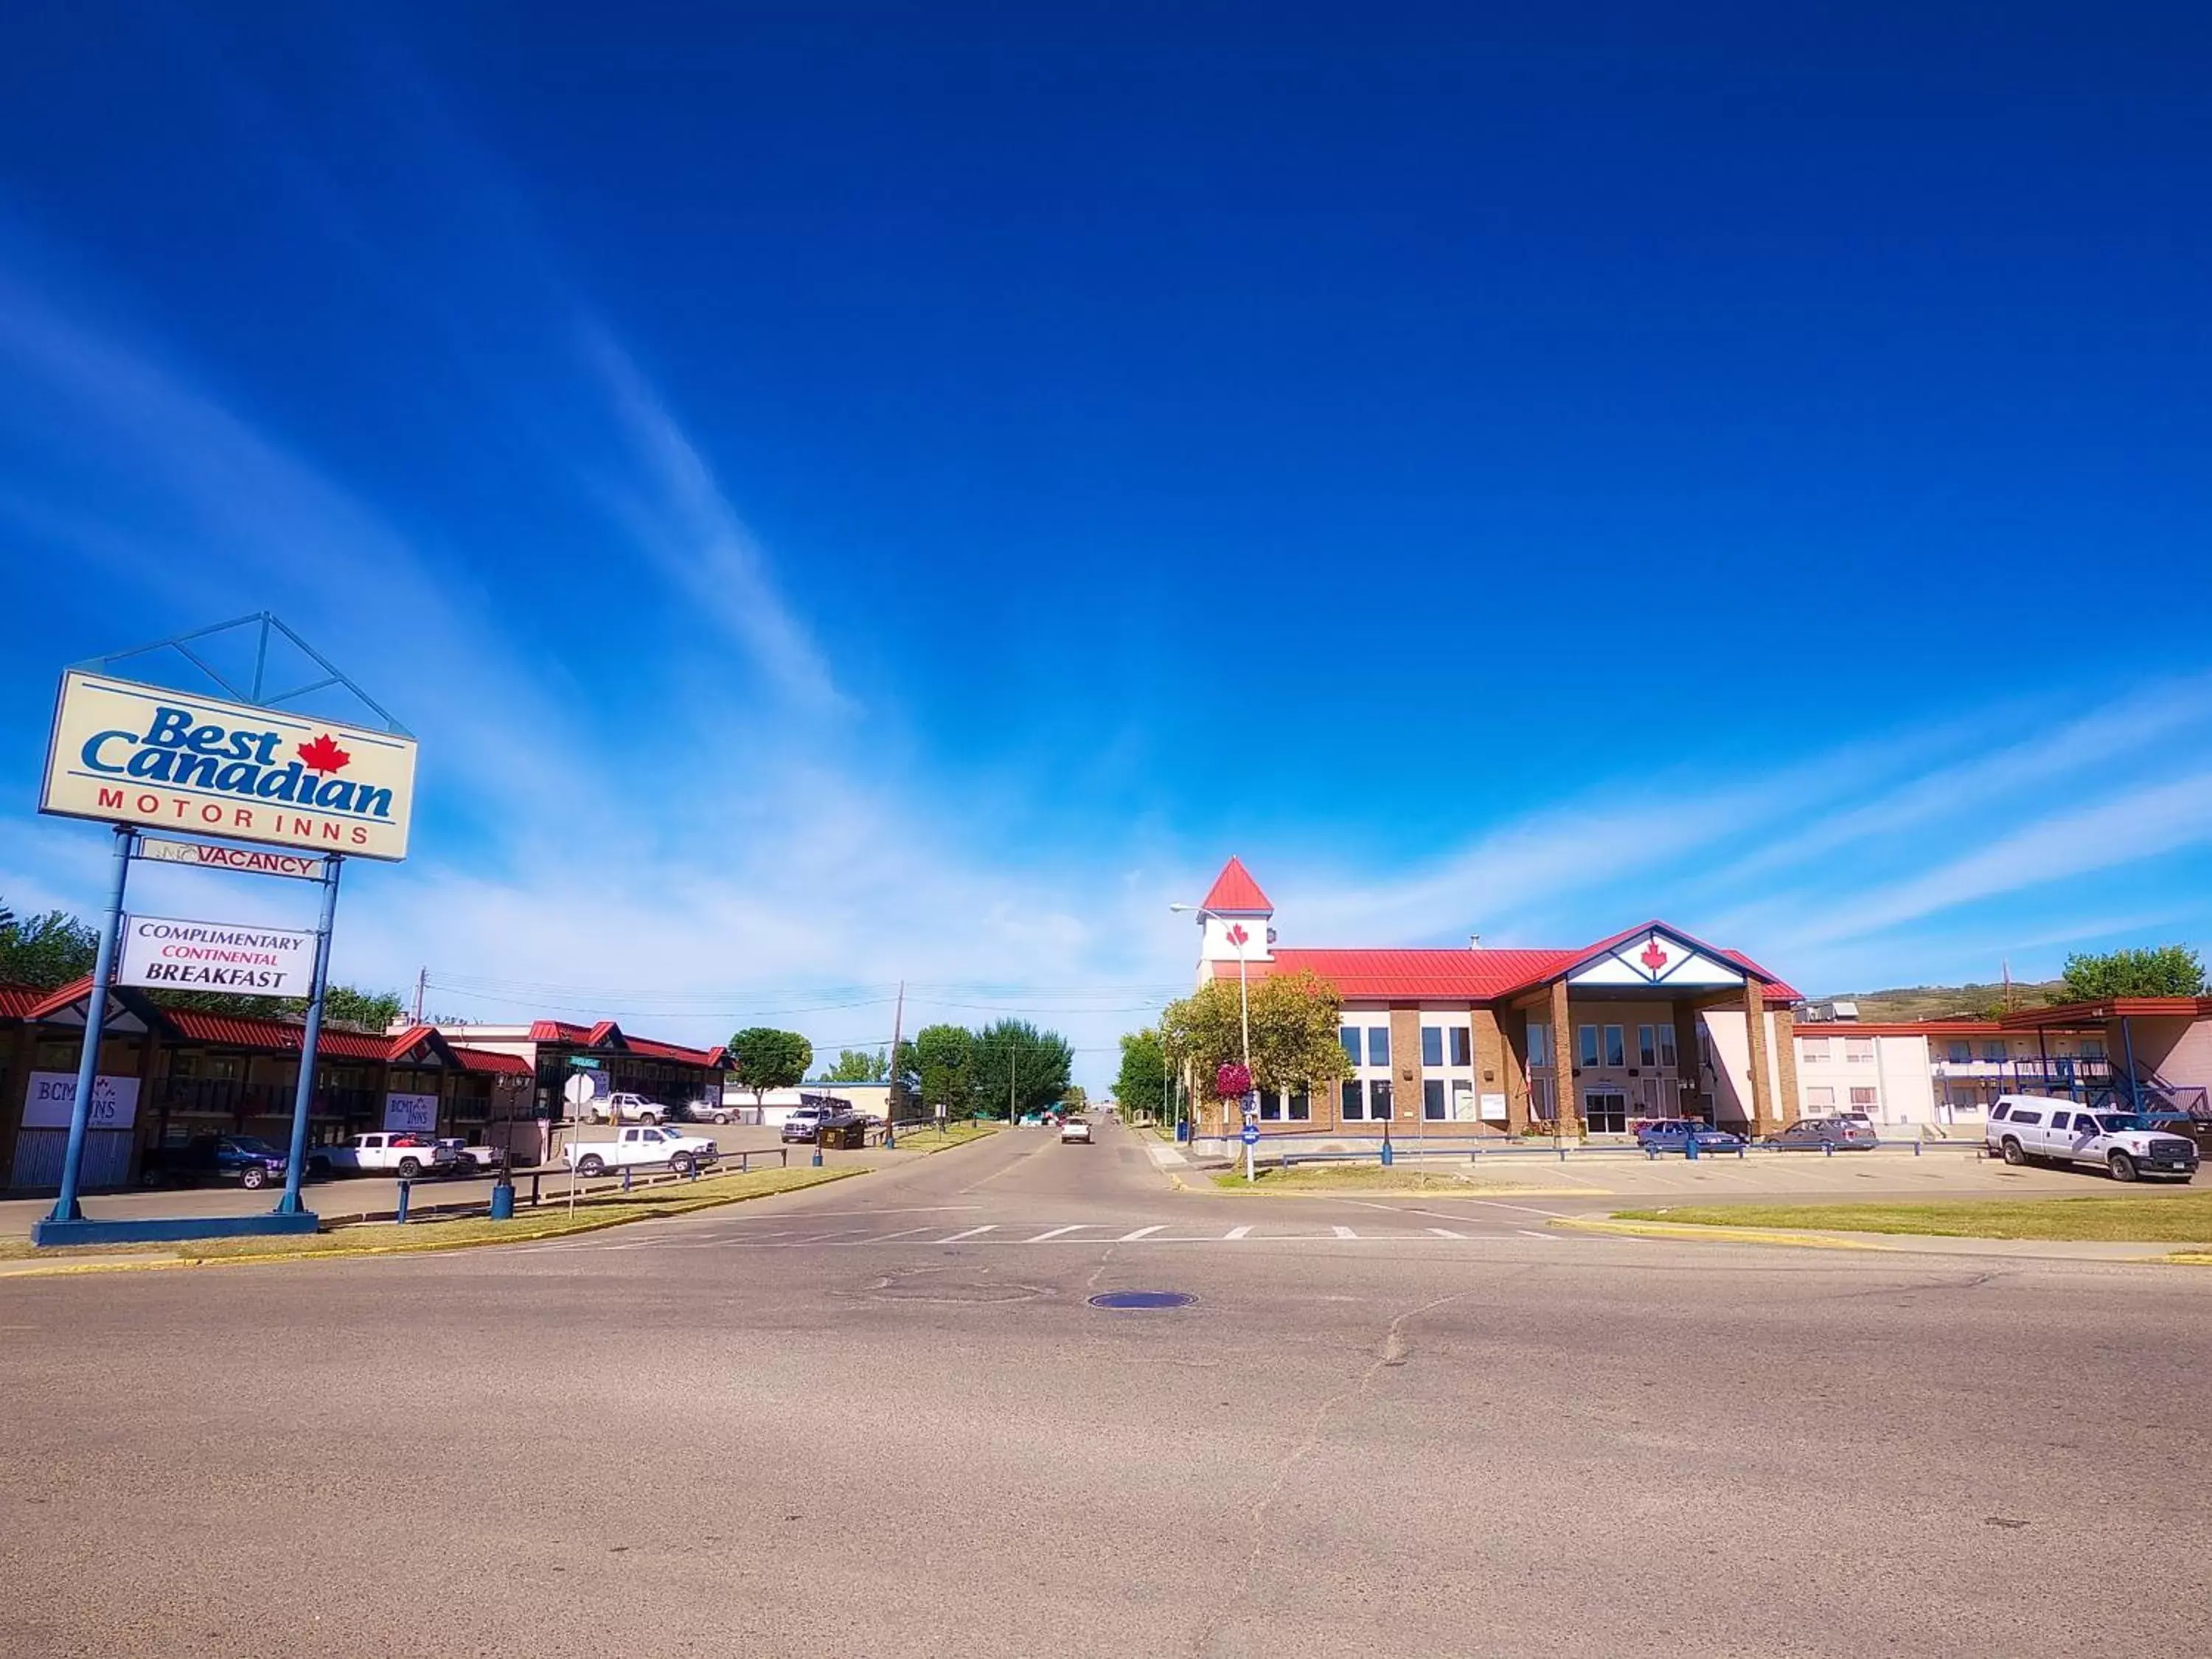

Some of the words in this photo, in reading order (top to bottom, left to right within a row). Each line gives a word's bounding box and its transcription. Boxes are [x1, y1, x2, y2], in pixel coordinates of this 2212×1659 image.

[142, 706, 282, 765] Best
[81, 730, 393, 817] Canadian
[98, 788, 253, 827] MOTOR
[275, 815, 367, 844] INNS
[197, 845, 313, 874] VACANCY
[139, 924, 305, 950] COMPLIMENTARY
[161, 945, 278, 966] CONTINENTAL
[145, 962, 288, 988] BREAKFAST
